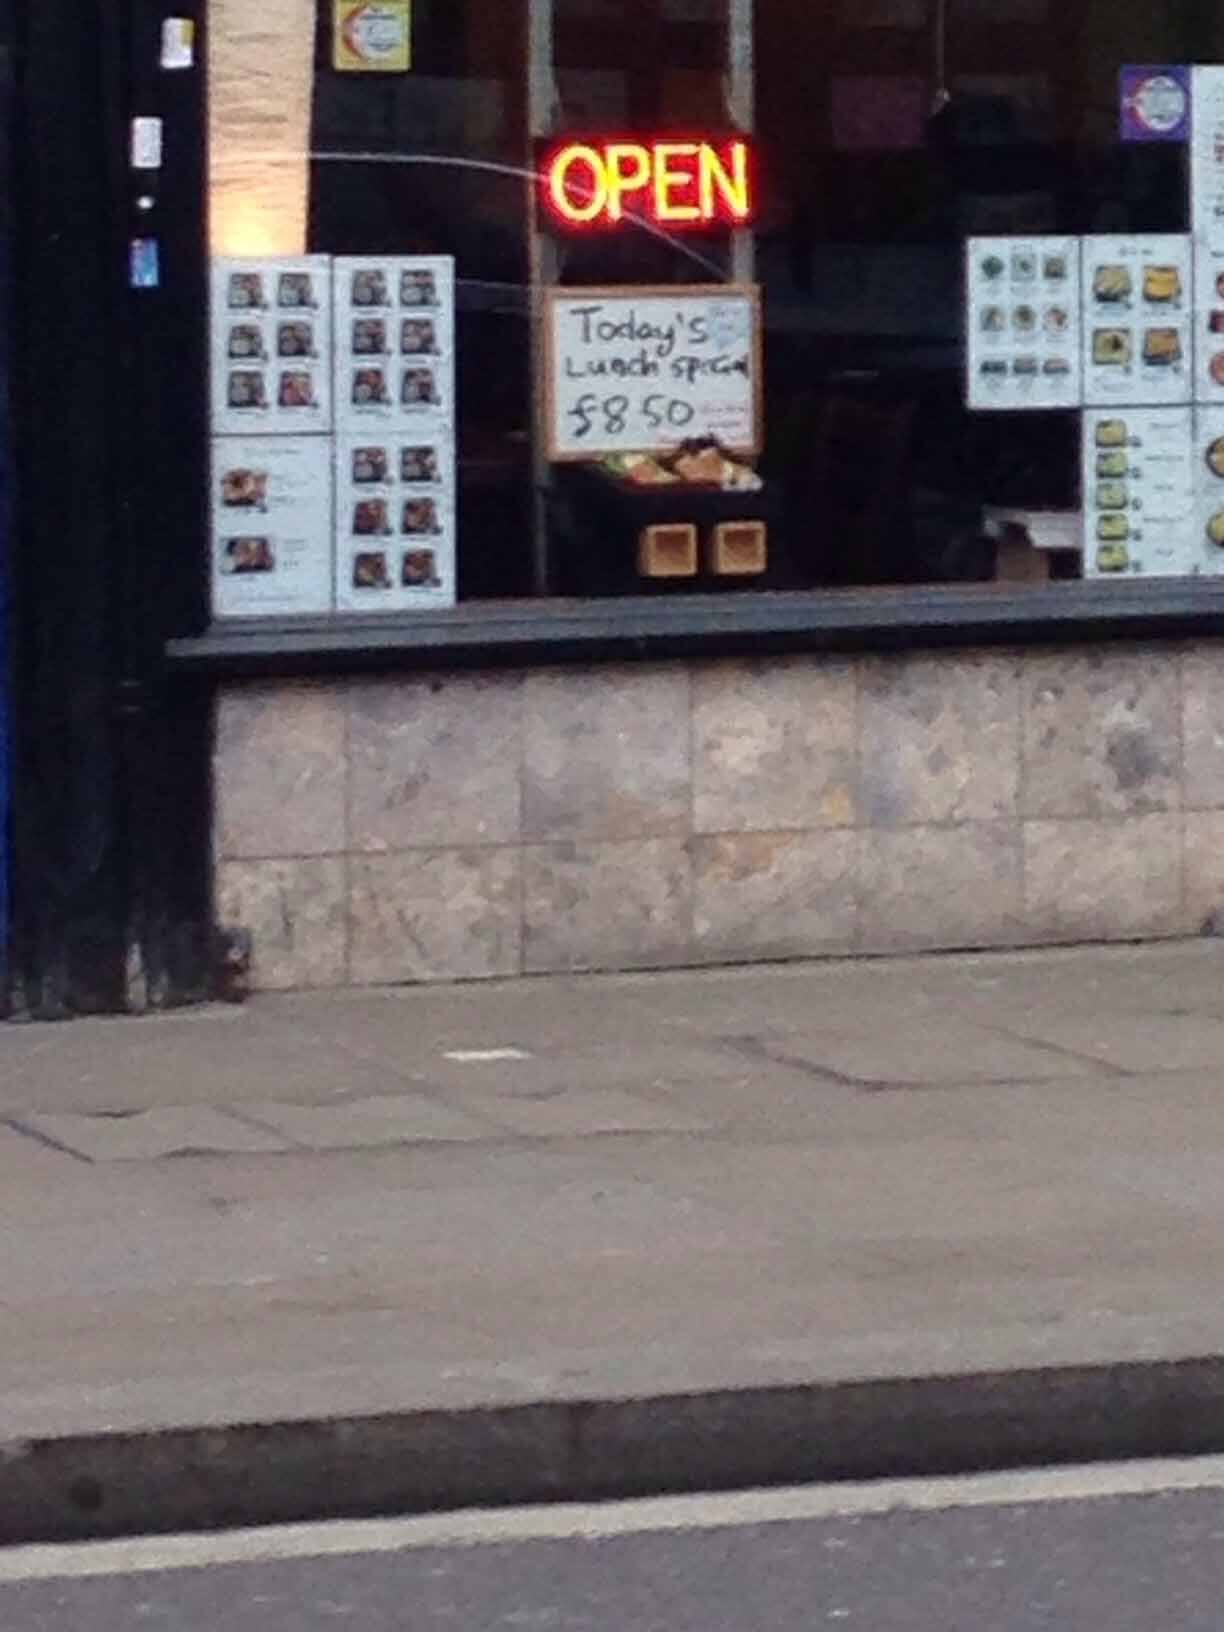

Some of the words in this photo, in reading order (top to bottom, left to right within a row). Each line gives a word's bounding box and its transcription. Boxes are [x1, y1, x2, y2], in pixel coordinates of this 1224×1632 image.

[550, 142, 750, 221] OPEN
[569, 305, 708, 357] Today's
[565, 348, 659, 378] Lunch
